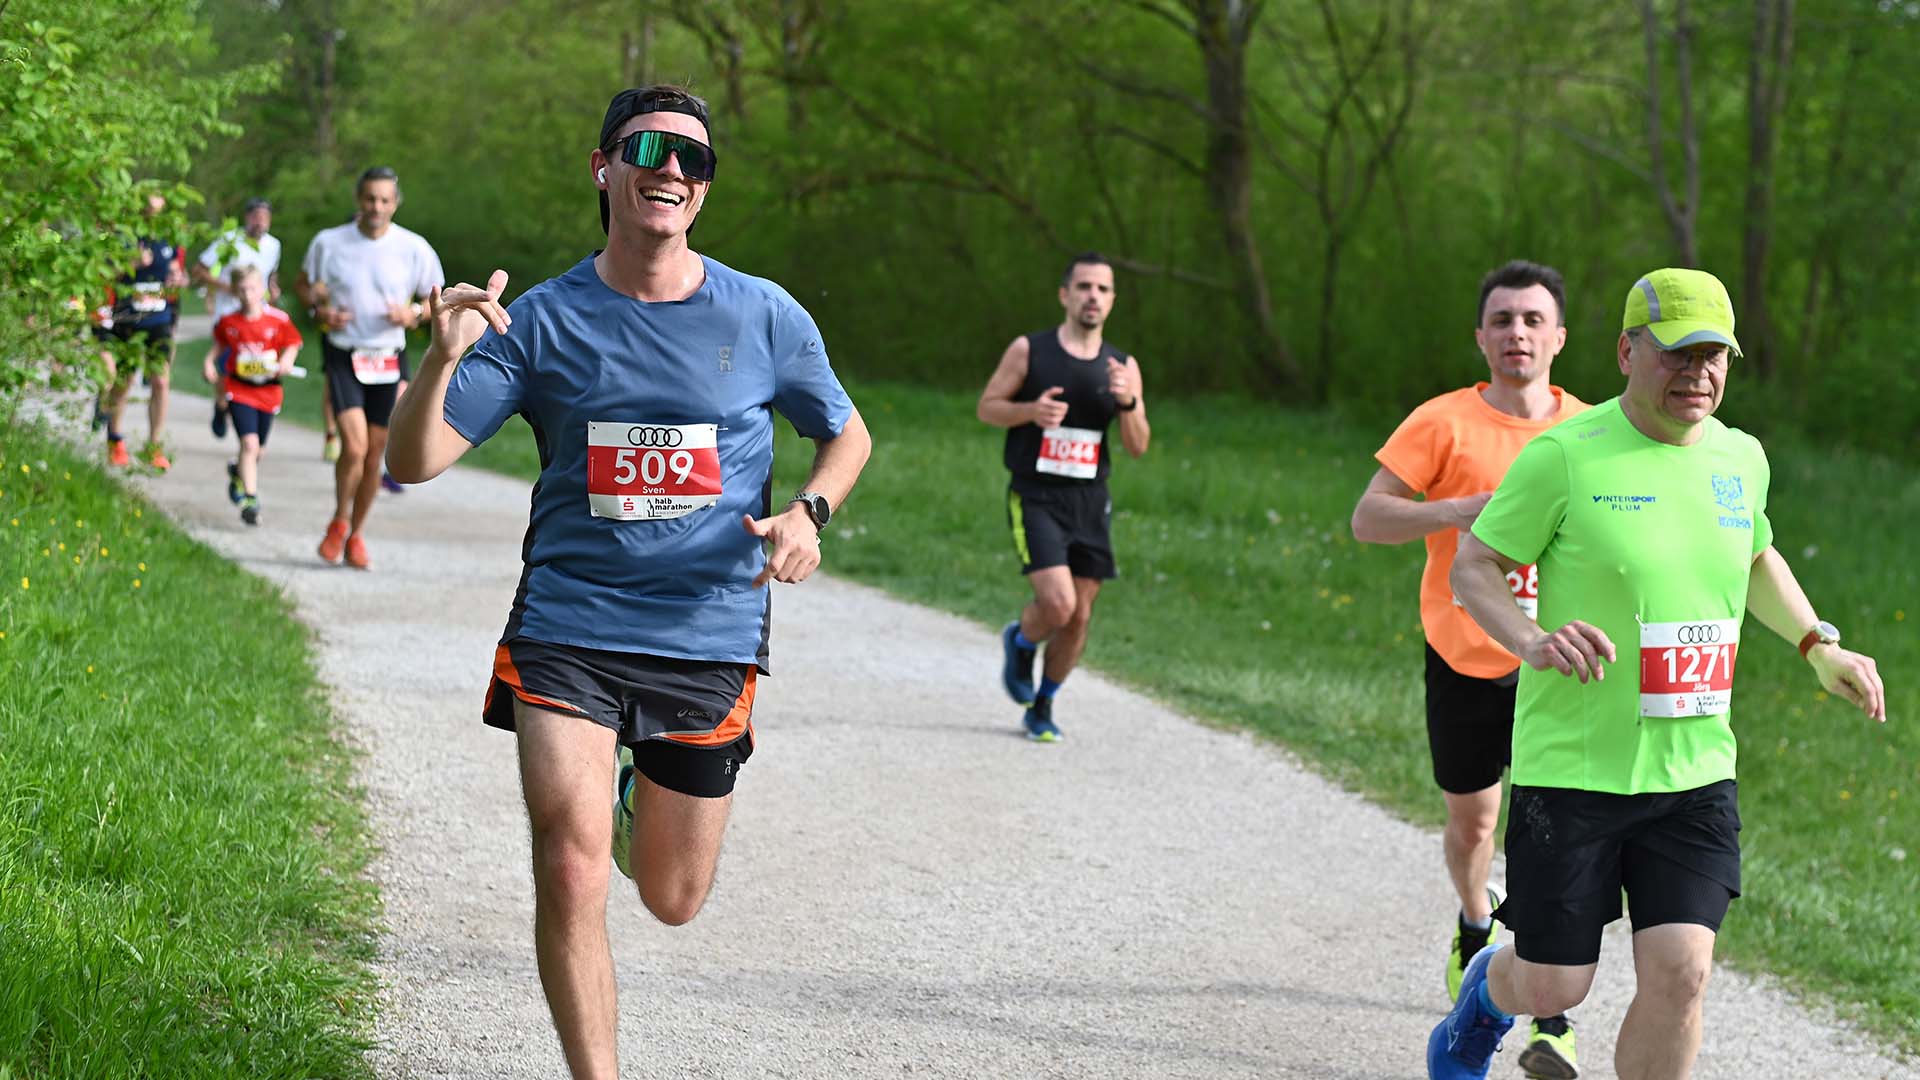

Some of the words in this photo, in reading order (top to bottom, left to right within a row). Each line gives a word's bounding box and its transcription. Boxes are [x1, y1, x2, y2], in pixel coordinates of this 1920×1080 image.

[1048, 438, 1094, 461] 1044
[614, 449, 694, 485] 509
[642, 486, 665, 494] Sven
[1603, 495, 1656, 503] INTERSPORT
[1663, 644, 1730, 684] 1271
